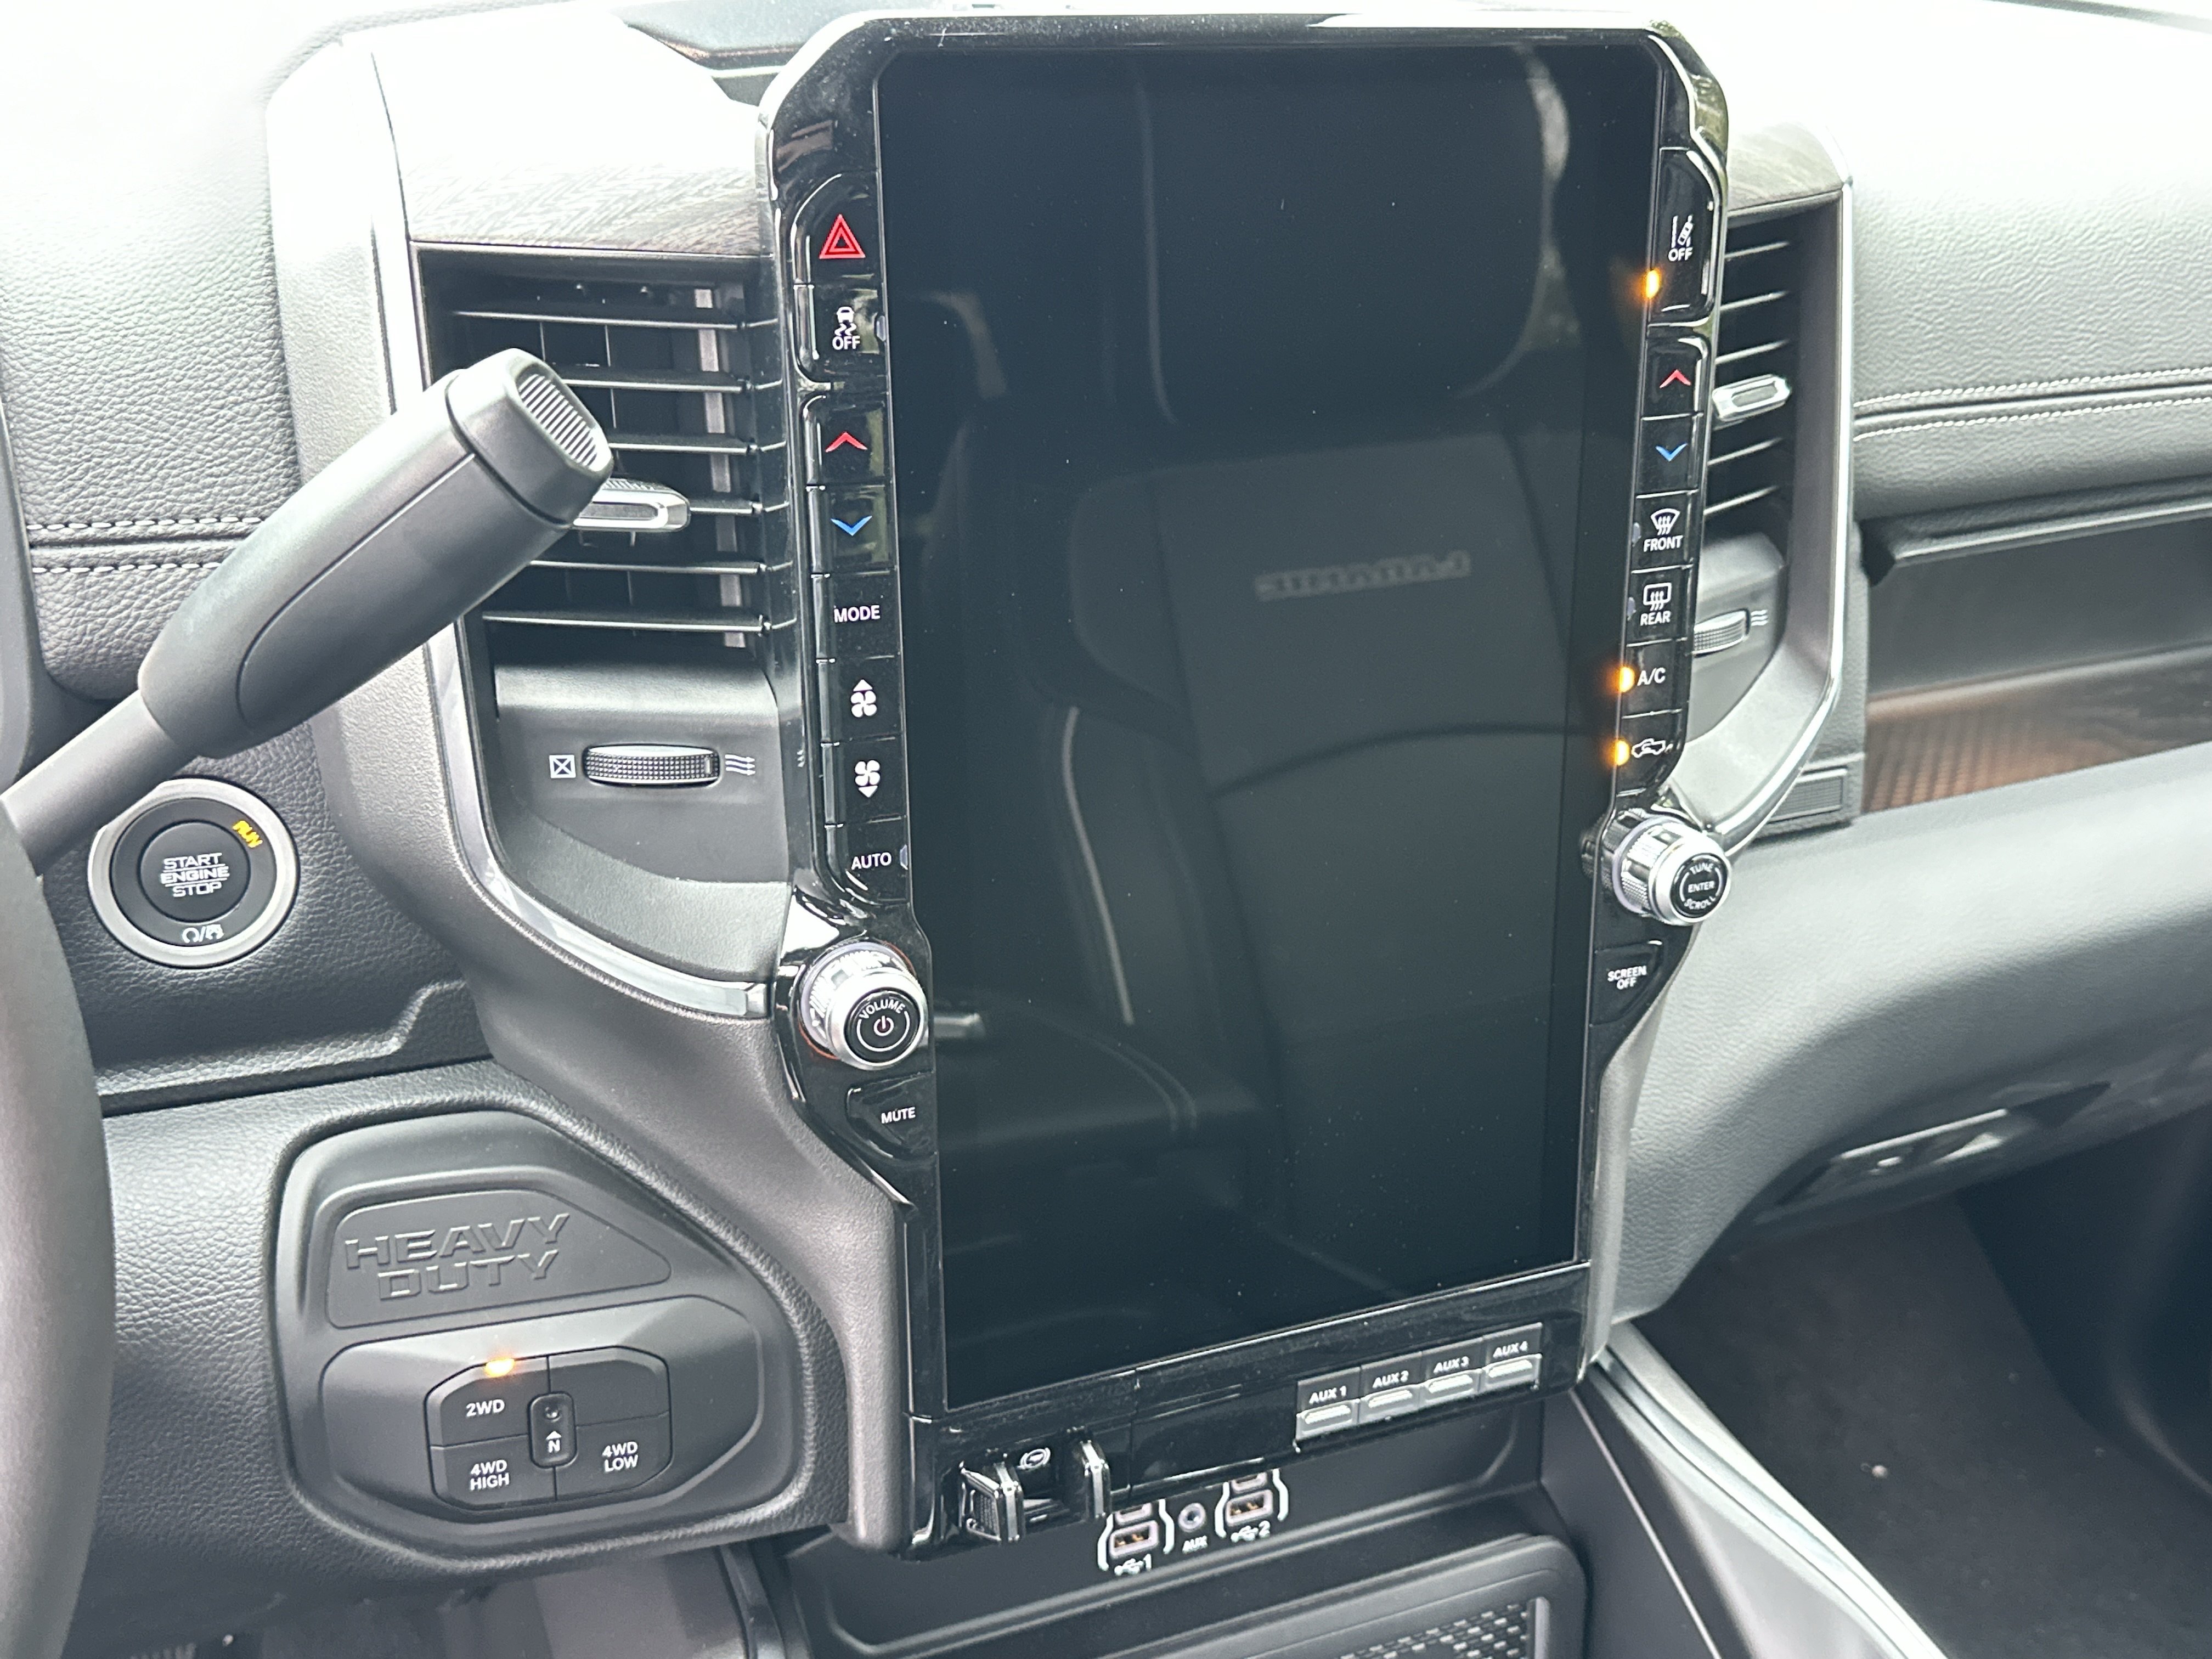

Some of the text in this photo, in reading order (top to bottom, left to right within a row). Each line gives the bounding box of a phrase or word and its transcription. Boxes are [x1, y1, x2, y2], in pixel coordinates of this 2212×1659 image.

[1668, 247, 1692, 262] OFF
[832, 335, 860, 351] OFF
[1643, 534, 1683, 553] FRONT
[833, 605, 881, 623] MODE
[1640, 611, 1672, 626] REAR
[1637, 667, 1666, 687] A/C
[163, 853, 222, 869] START
[851, 851, 892, 871] AUTO
[1689, 862, 1715, 877] TUNE
[160, 866, 230, 884] ENGINE
[173, 882, 222, 898] STOP
[1688, 881, 1715, 893] ENTER
[1684, 895, 1716, 911] SCROLL
[1607, 966, 1647, 983] SCREEN
[1616, 977, 1637, 990] OFF
[859, 998, 906, 1019] VOLUME
[881, 1107, 916, 1124] MUTE
[344, 1212, 570, 1270] HEAVY
[377, 1249, 559, 1300] DUTY
[1493, 1341, 1528, 1358] AUX 4
[1434, 1357, 1470, 1373] AUX 3
[1372, 1370, 1409, 1389] AUX 2
[1309, 1386, 1347, 1404] AUX 1
[465, 1398, 505, 1418] 2WD
[548, 1439, 560, 1453] N
[601, 1441, 638, 1458] 4WD
[470, 1459, 507, 1477] 4WD
[604, 1454, 639, 1472] LOW
[469, 1473, 510, 1492] HIGH
[1259, 1520, 1271, 1538] 2
[1182, 1536, 1207, 1554] AUX
[1143, 1553, 1152, 1571] 1
